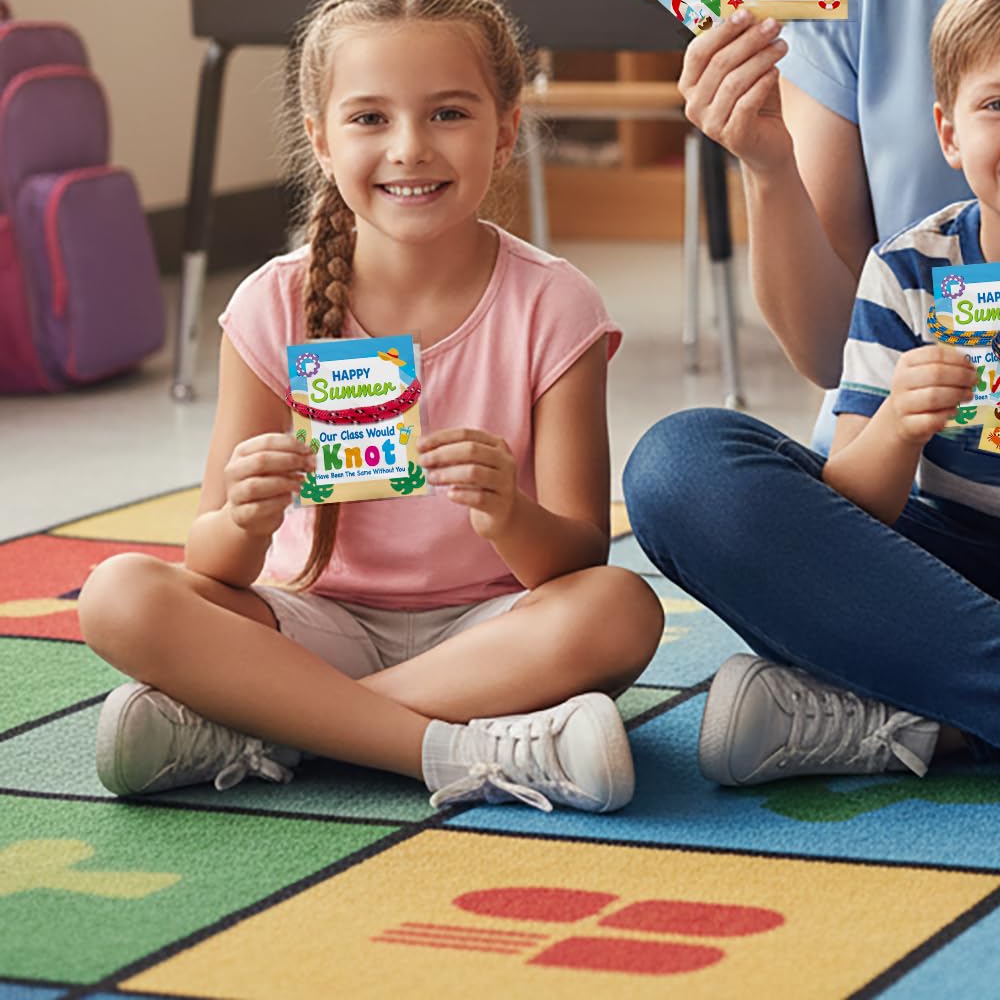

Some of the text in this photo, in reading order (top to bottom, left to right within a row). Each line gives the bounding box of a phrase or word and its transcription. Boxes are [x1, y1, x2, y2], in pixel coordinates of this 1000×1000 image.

[332, 367, 370, 382] HAPPY
[310, 377, 397, 403] Summer
[319, 426, 395, 443] Our Class Would
[322, 438, 397, 471] Knot
[330, 471, 344, 479] Been
[357, 469, 372, 477] Same
[373, 466, 395, 475] Without
[395, 465, 406, 473] You
